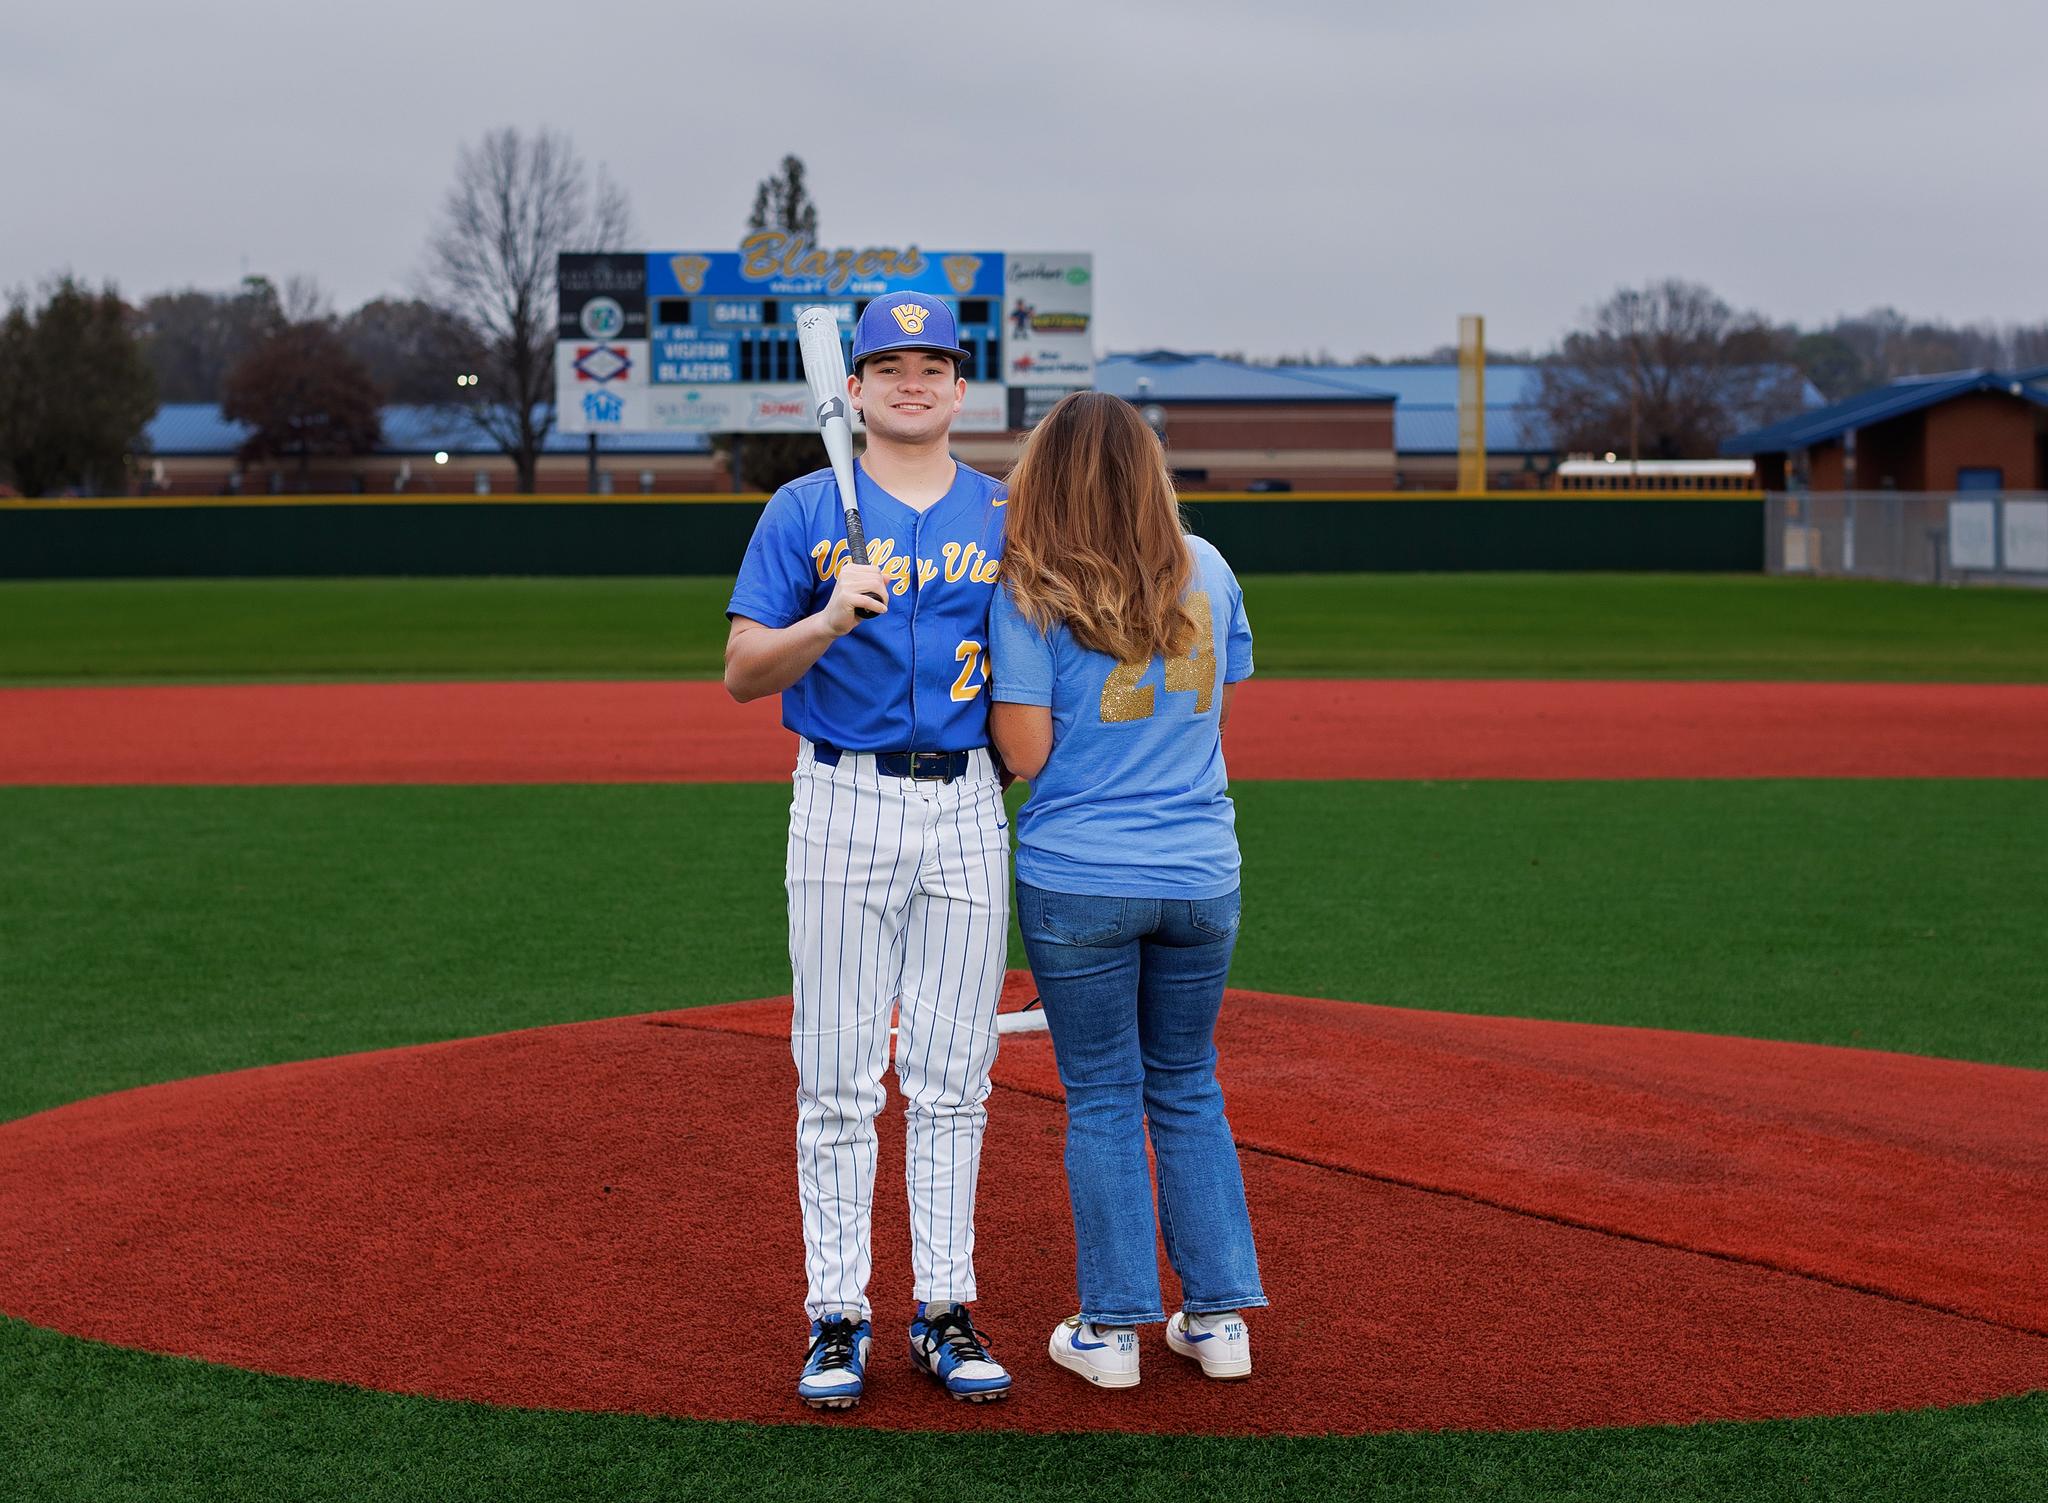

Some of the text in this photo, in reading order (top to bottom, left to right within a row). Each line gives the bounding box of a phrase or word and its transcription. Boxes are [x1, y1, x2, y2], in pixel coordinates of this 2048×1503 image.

[741, 231, 927, 293] Blazers
[714, 303, 758, 322] BALL
[663, 342, 729, 359] VISITOR
[658, 362, 733, 380] BLAZERS
[942, 541, 1001, 584] Vie
[1225, 1322, 1242, 1334] NIKE
[1228, 1332, 1241, 1341] AIR
[1117, 1333, 1134, 1343] NIKE
[1120, 1343, 1133, 1351] AIR
